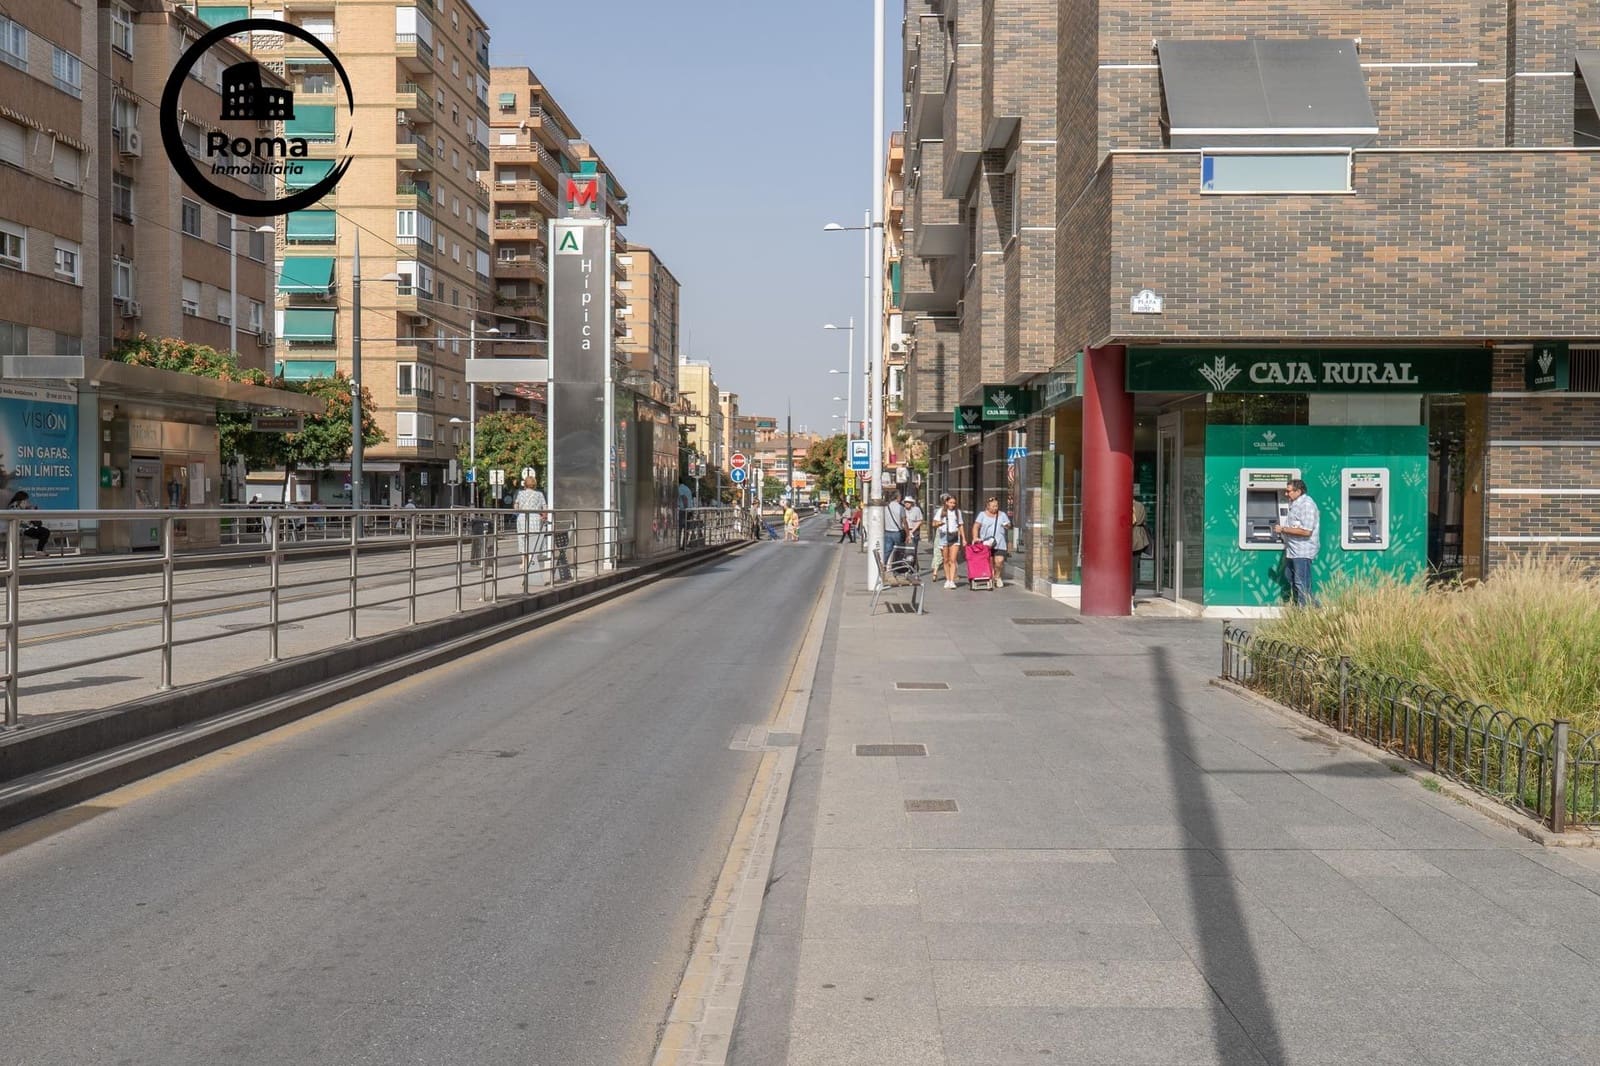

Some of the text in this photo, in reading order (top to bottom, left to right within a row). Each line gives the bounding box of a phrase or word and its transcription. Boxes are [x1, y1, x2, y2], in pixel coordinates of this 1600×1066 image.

[566, 178, 597, 209] M
[559, 231, 579, 251] A
[581, 259, 592, 350] Hípica
[1250, 362, 1418, 384] CAJA RURAL
[17, 446, 70, 459] SIN GAFAS.
[15, 462, 73, 477] SIN LÍMITES.
